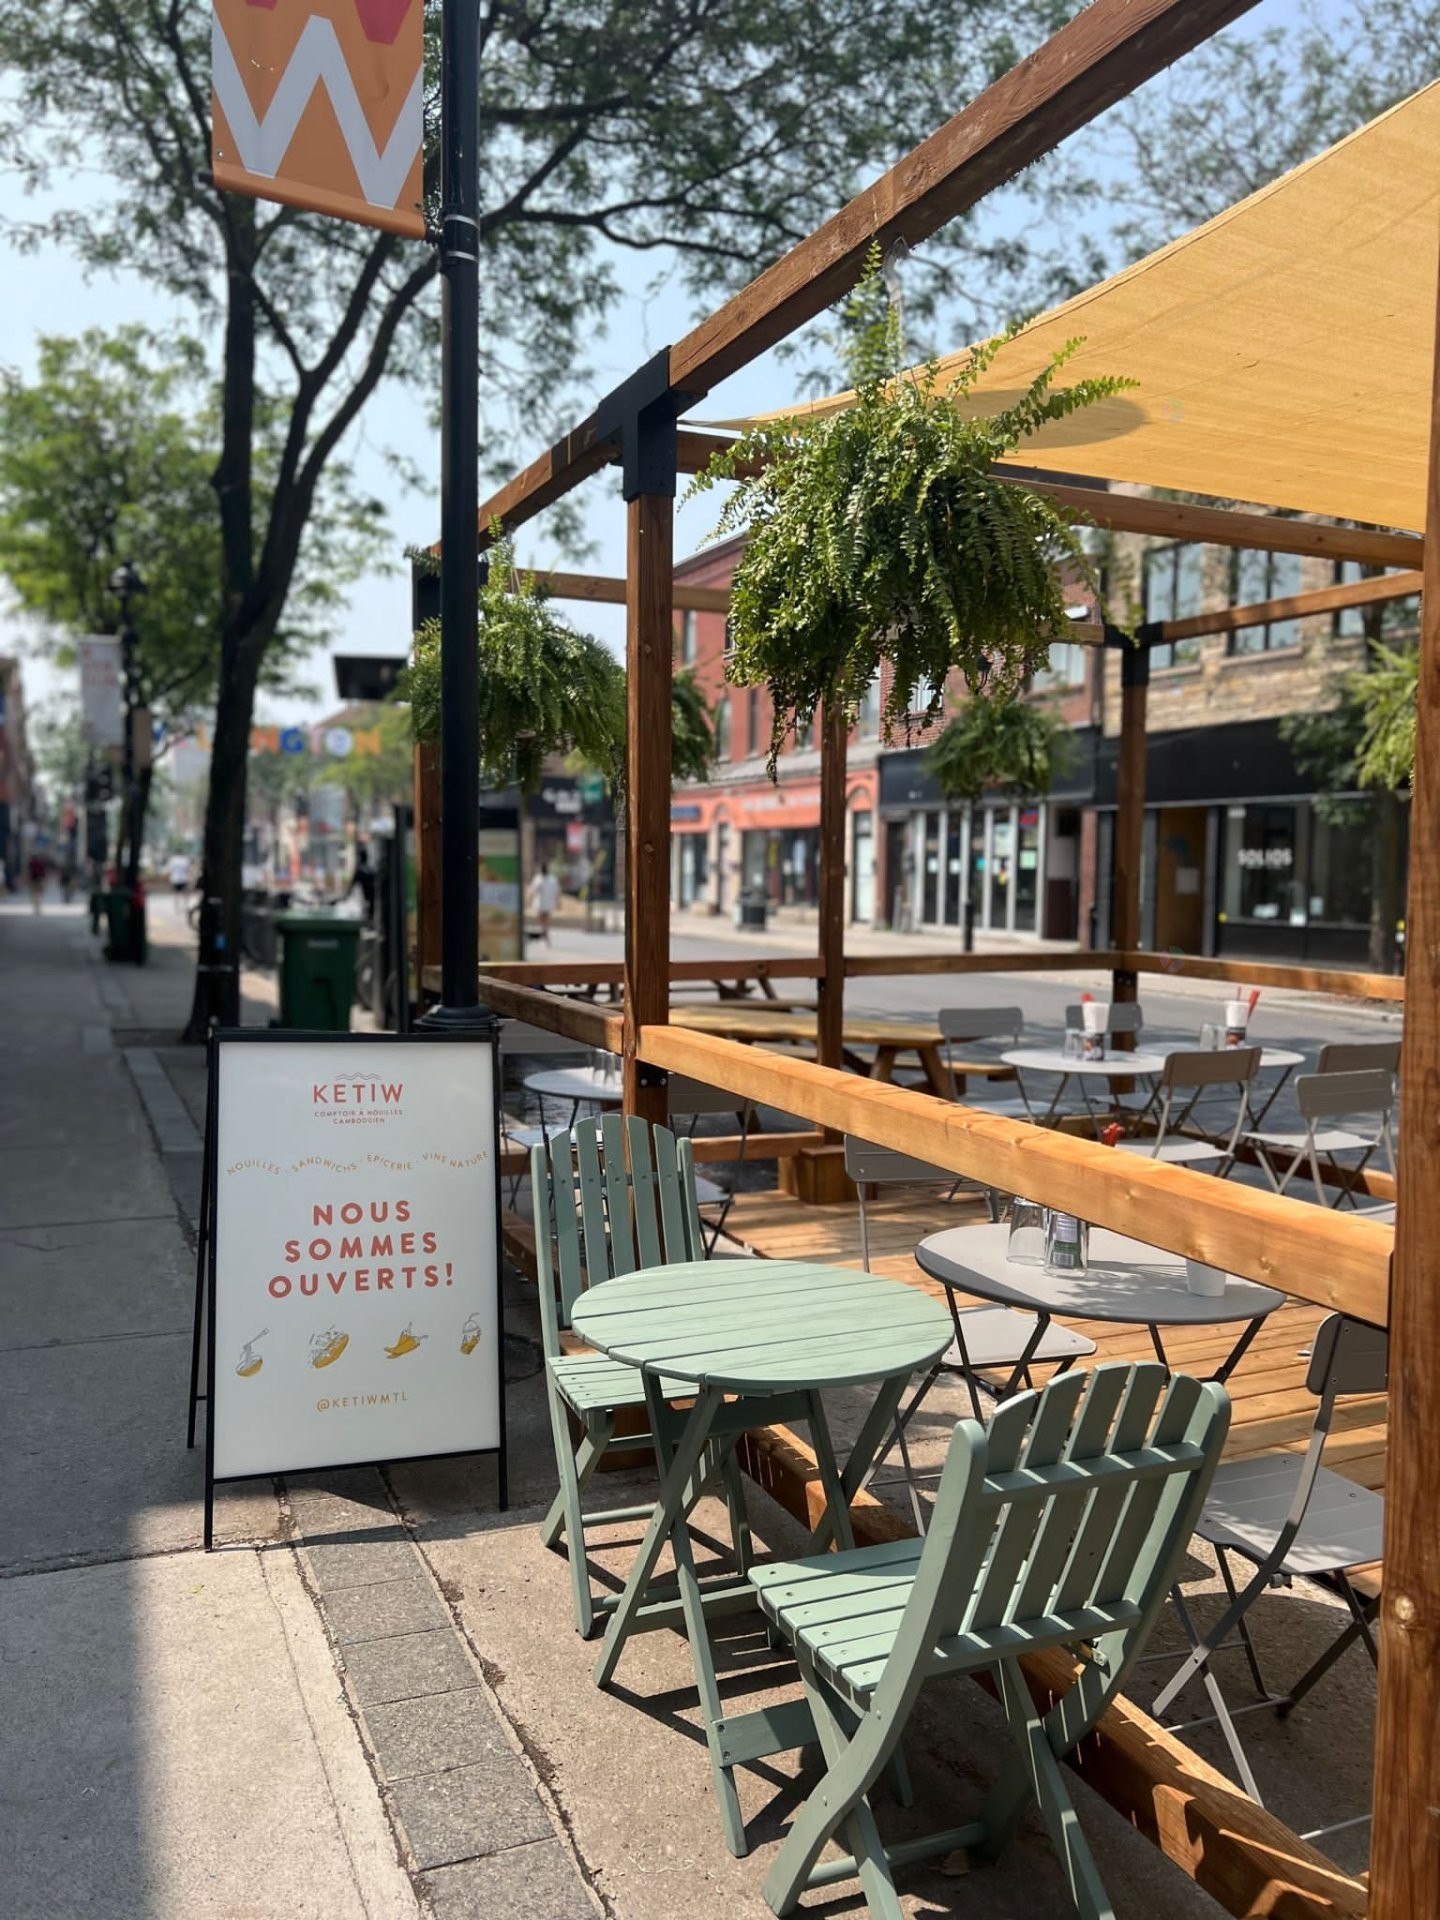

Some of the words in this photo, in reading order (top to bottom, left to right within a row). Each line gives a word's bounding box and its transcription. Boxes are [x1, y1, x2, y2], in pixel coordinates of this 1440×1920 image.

[313, 1083, 404, 1103] KETIW
[314, 1110, 356, 1118] COMPTOIR
[332, 1117, 386, 1125] CAMBODGIEN
[227, 1159, 281, 1176] NOUILLES
[291, 1156, 358, 1174] SANDWICHS
[422, 1152, 448, 1164] VINS
[449, 1150, 489, 1169] NATURE
[312, 1200, 412, 1226] NOUS
[284, 1231, 438, 1263] SOMMES
[268, 1262, 453, 1298] OUVERTS!
[316, 1391, 409, 1413] @KETIWMTL
